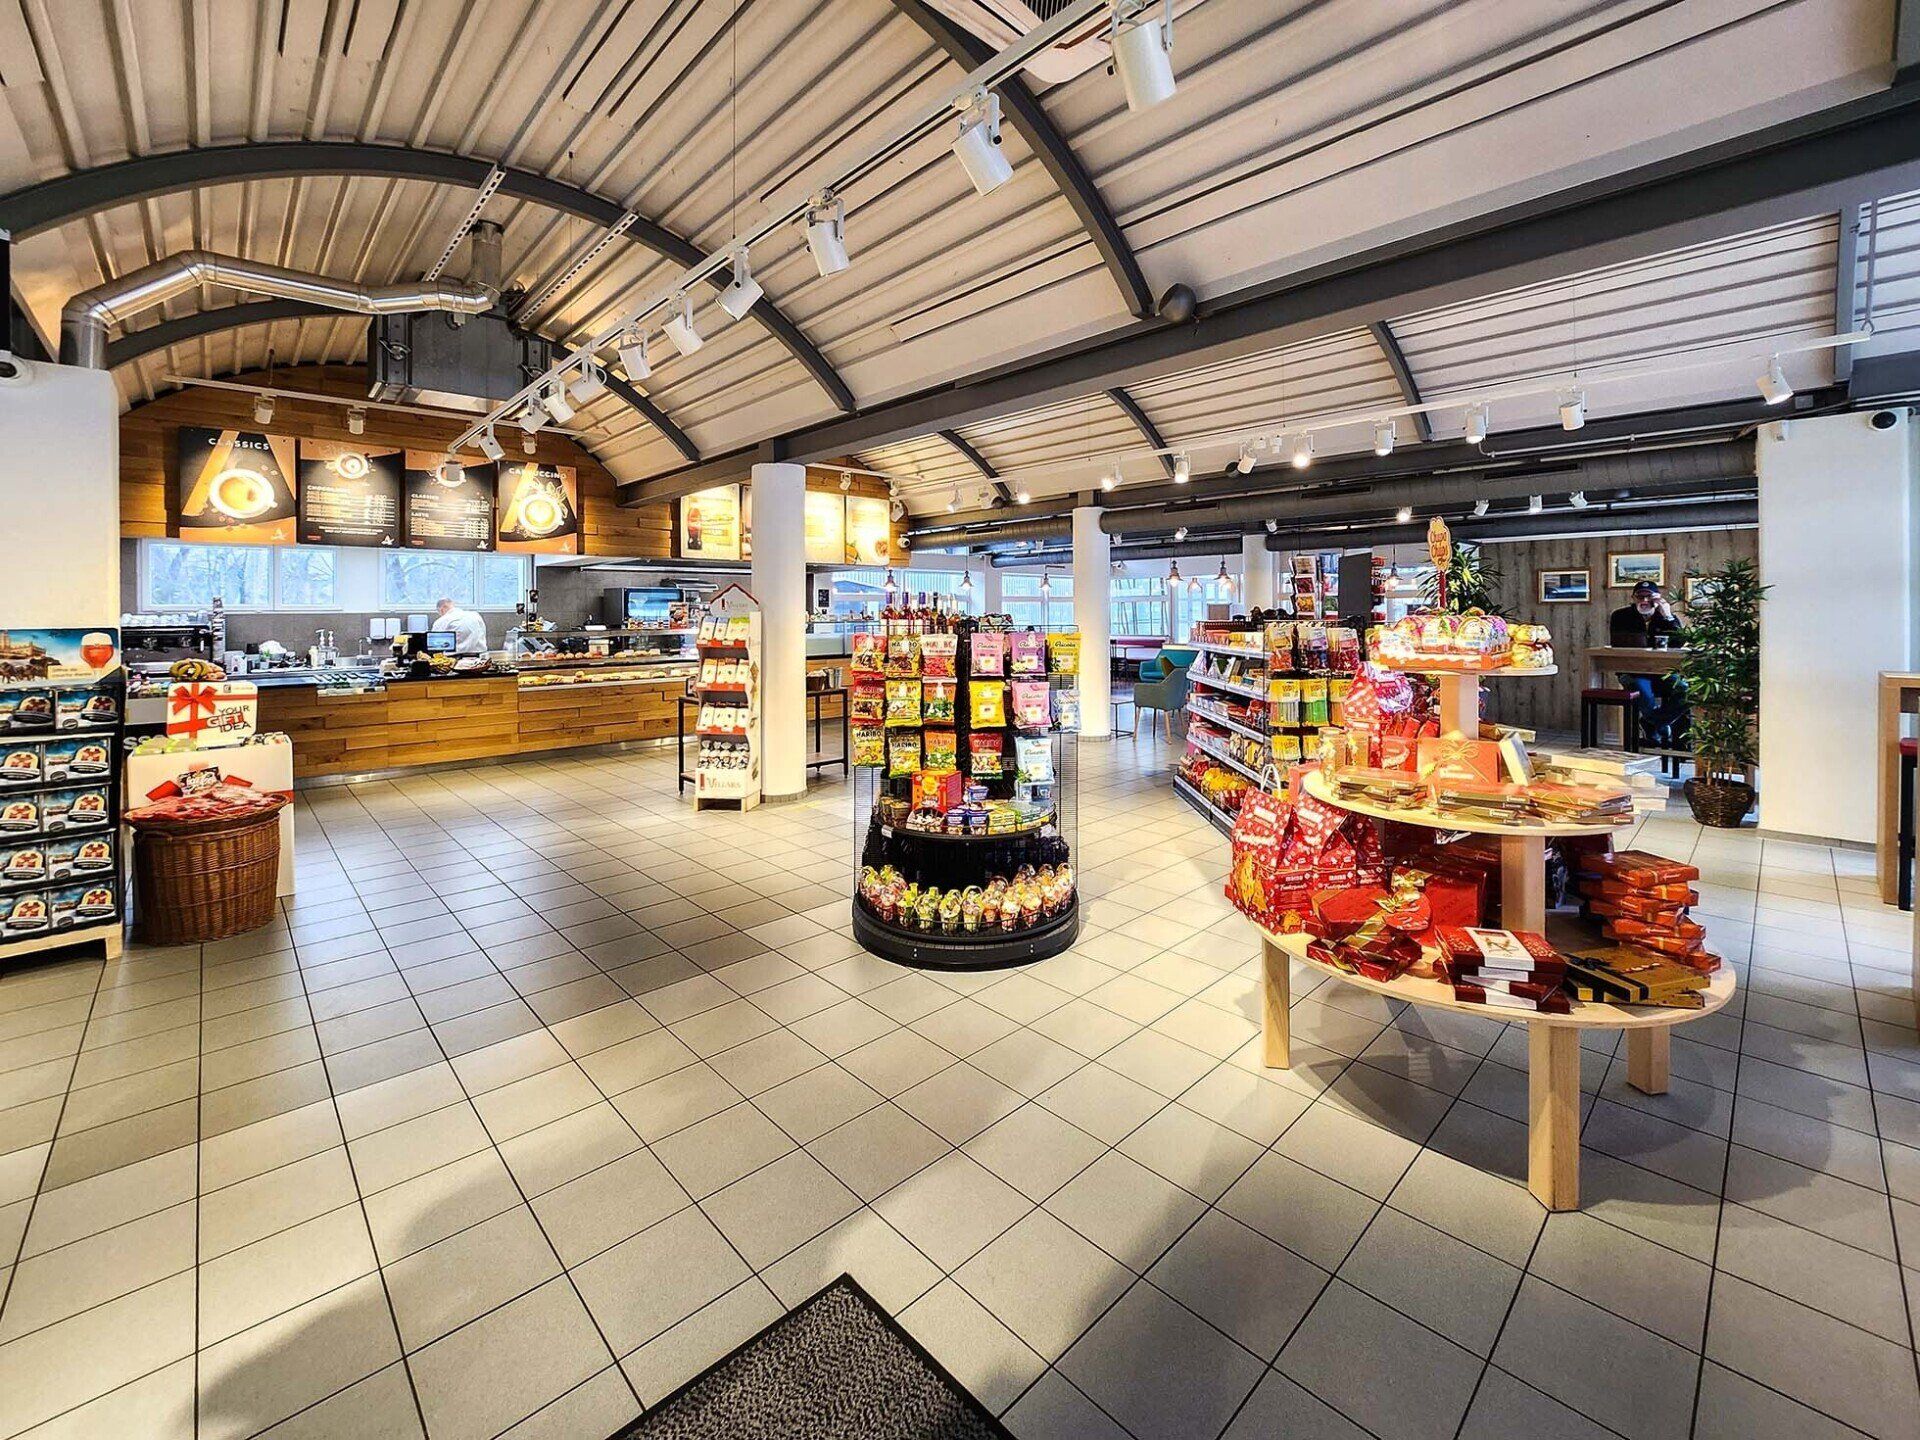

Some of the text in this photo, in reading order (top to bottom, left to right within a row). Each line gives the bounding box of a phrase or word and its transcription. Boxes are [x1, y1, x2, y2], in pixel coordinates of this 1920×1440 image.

[218, 704, 250, 715] YOUR
[206, 712, 245, 728] GIFT
[219, 720, 251, 733] IDEA
[856, 729, 882, 738] HARIBO
